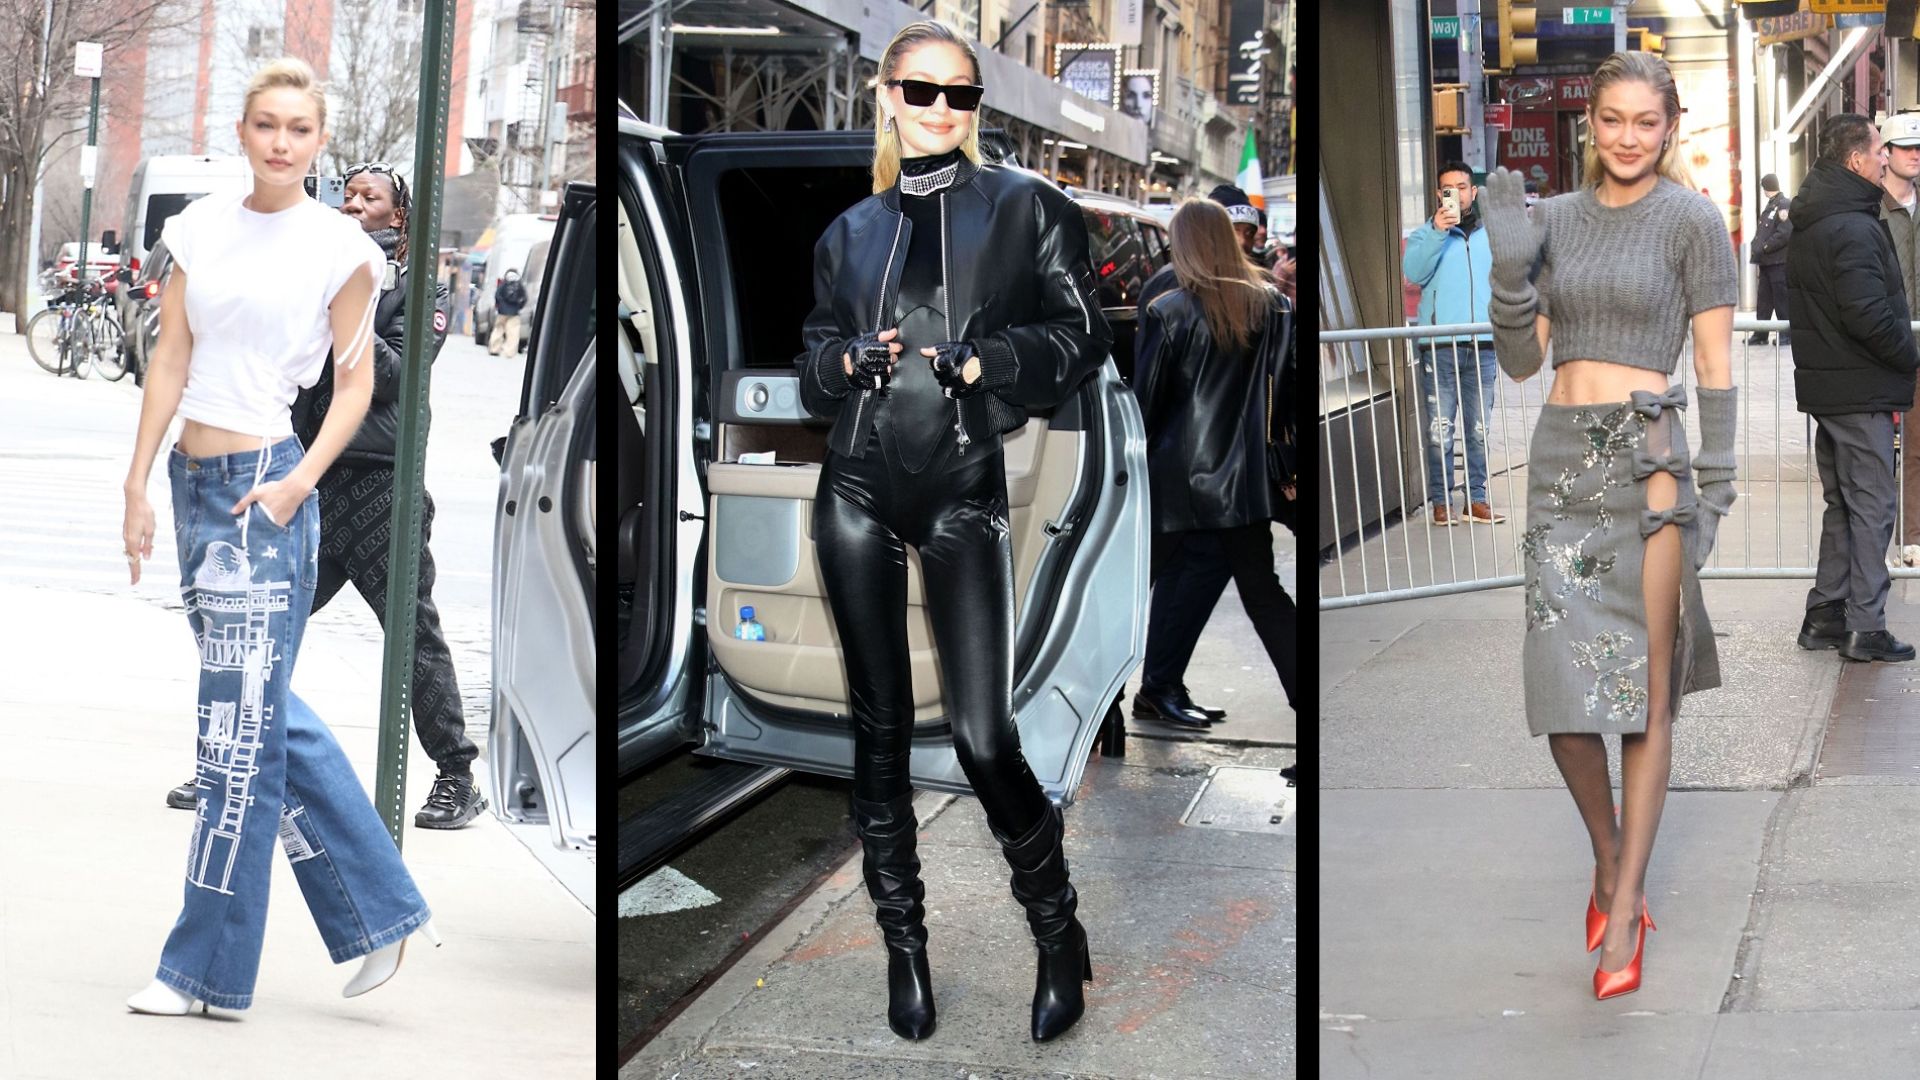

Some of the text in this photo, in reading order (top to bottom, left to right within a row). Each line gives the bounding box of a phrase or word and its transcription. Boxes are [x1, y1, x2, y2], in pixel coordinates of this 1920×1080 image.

[1583, 9, 1589, 22] 7
[1430, 20, 1458, 38] way
[1563, 85, 1591, 98] RAI
[1511, 127, 1546, 143] ONE
[1507, 142, 1550, 158] LOVE
